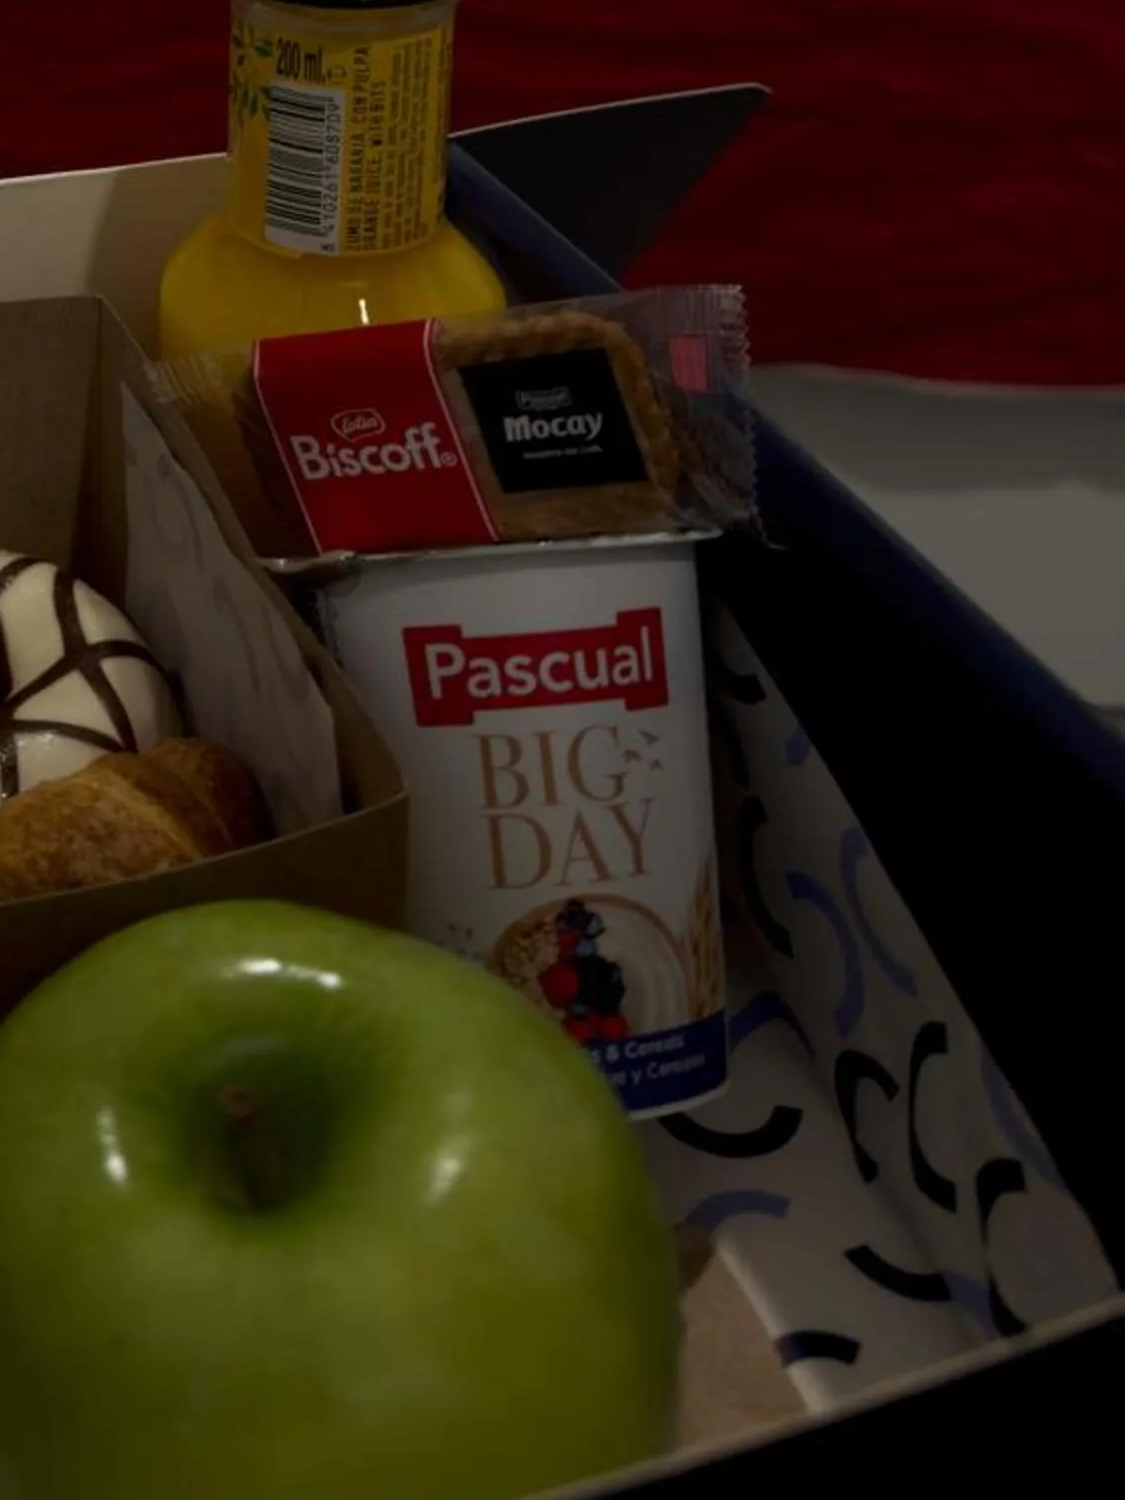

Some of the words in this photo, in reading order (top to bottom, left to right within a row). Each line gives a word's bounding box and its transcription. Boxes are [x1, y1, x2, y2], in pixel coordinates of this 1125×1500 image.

[276, 37, 300, 80] 200
[290, 421, 442, 482] Biscoff
[502, 411, 604, 443] Mocay
[423, 624, 654, 700] Pascual
[473, 724, 627, 811] BIG
[483, 798, 653, 891] DAY
